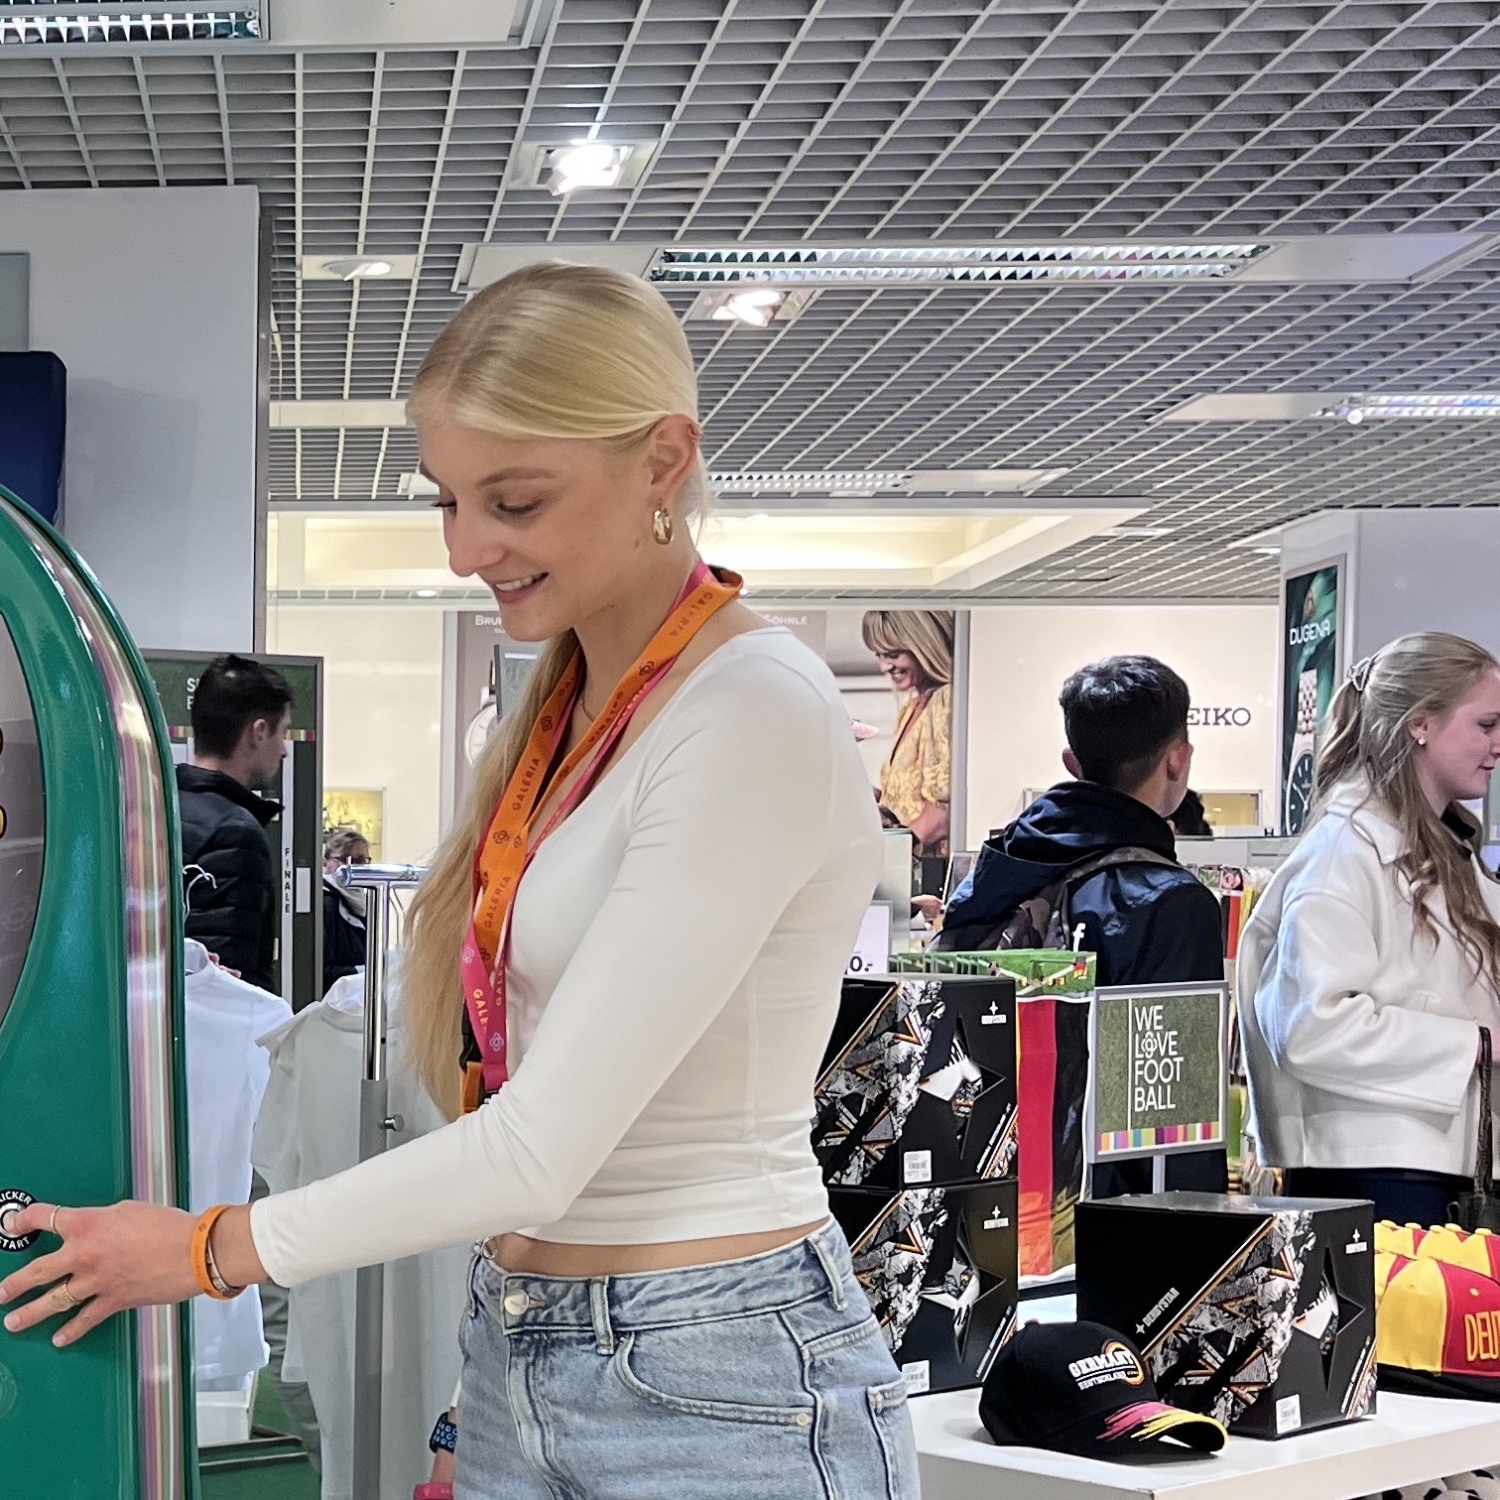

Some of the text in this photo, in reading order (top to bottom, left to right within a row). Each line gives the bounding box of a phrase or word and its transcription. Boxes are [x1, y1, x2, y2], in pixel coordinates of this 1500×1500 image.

[1290, 619, 1331, 646] DUGENA
[1187, 707, 1251, 726] EIKO
[512, 757, 541, 811] GALERIA
[483, 875, 512, 928] GALERIA
[844, 955, 873, 975] 0.-
[473, 988, 490, 1034] GALE
[1134, 1005, 1164, 1032] WE
[1135, 1030, 1178, 1059] LOVE
[1134, 1056, 1184, 1086] FOOT
[1134, 1084, 1176, 1112] BALL
